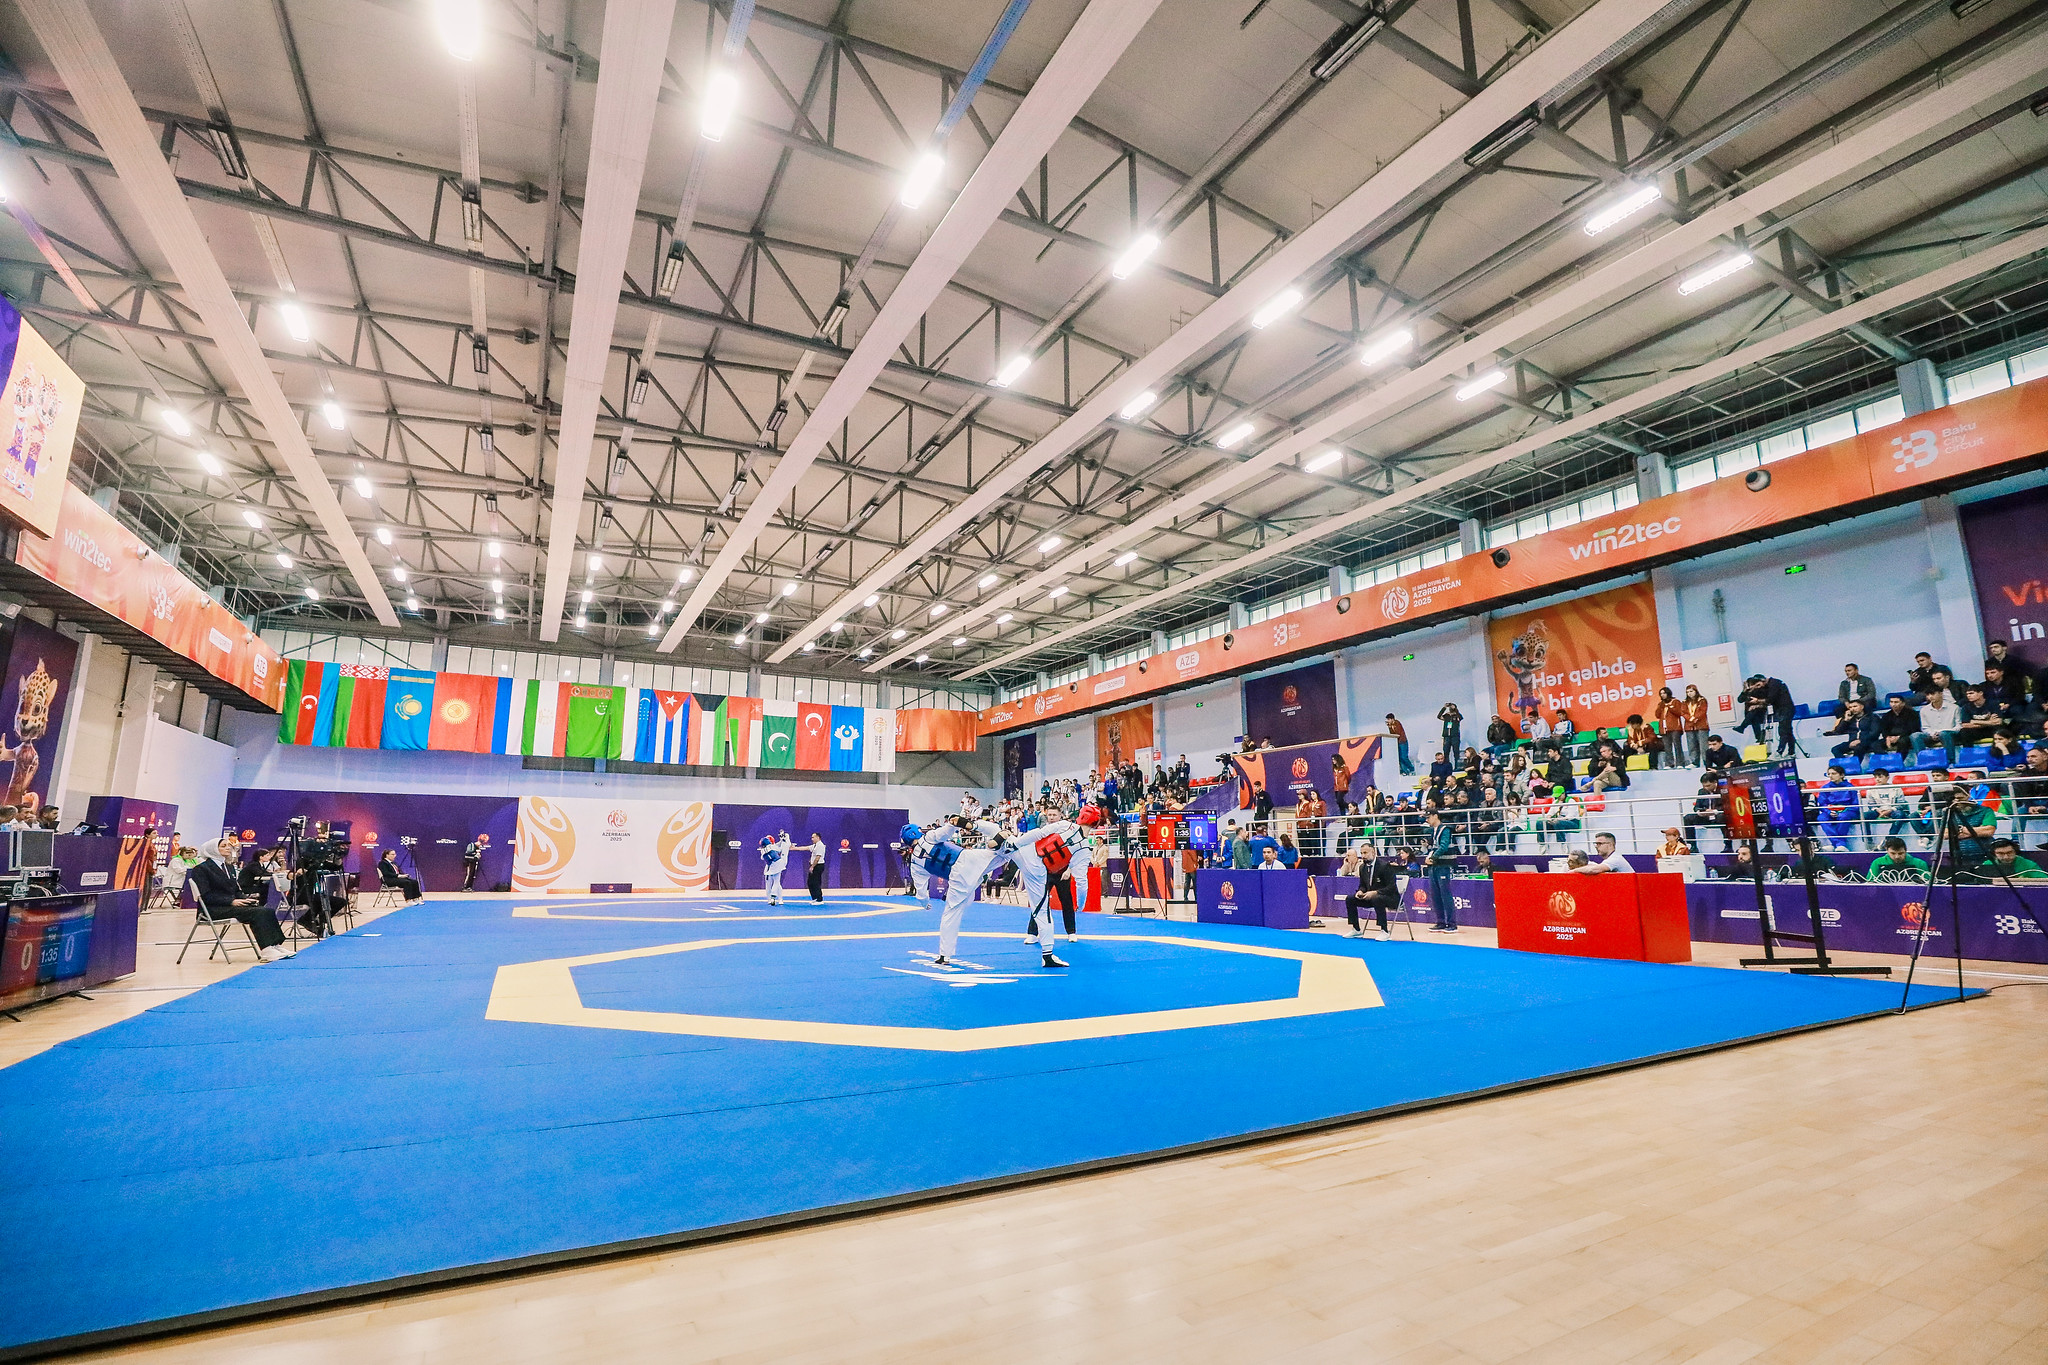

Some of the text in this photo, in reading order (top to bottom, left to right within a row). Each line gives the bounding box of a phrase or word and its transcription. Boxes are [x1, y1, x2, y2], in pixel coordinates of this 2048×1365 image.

[1942, 422, 1976, 437] Baku
[1568, 516, 1681, 560] win2tec
[64, 528, 112, 573] win2tec
[1413, 580, 1461, 599] AZƏRBAYCAN
[1413, 596, 1432, 607] 2025
[2009, 618, 2045, 641] in
[1180, 656, 1196, 668] AZE
[1531, 672, 1564, 689] Hər
[1569, 656, 1636, 686] qəlbdə
[1548, 678, 1654, 710] bir qələbə!
[990, 711, 1013, 725] win2tec
[1736, 797, 1745, 816] 0
[1752, 802, 1768, 813] 1:35
[1773, 793, 1783, 813] 0
[1161, 826, 1169, 837] 0
[1195, 826, 1202, 837] 0
[1762, 829, 1766, 837] 2
[1543, 926, 1586, 934] AZƏRBAYCAN
[21, 942, 33, 971] 0
[41, 948, 59, 963] 1:35
[65, 935, 75, 961] 0
